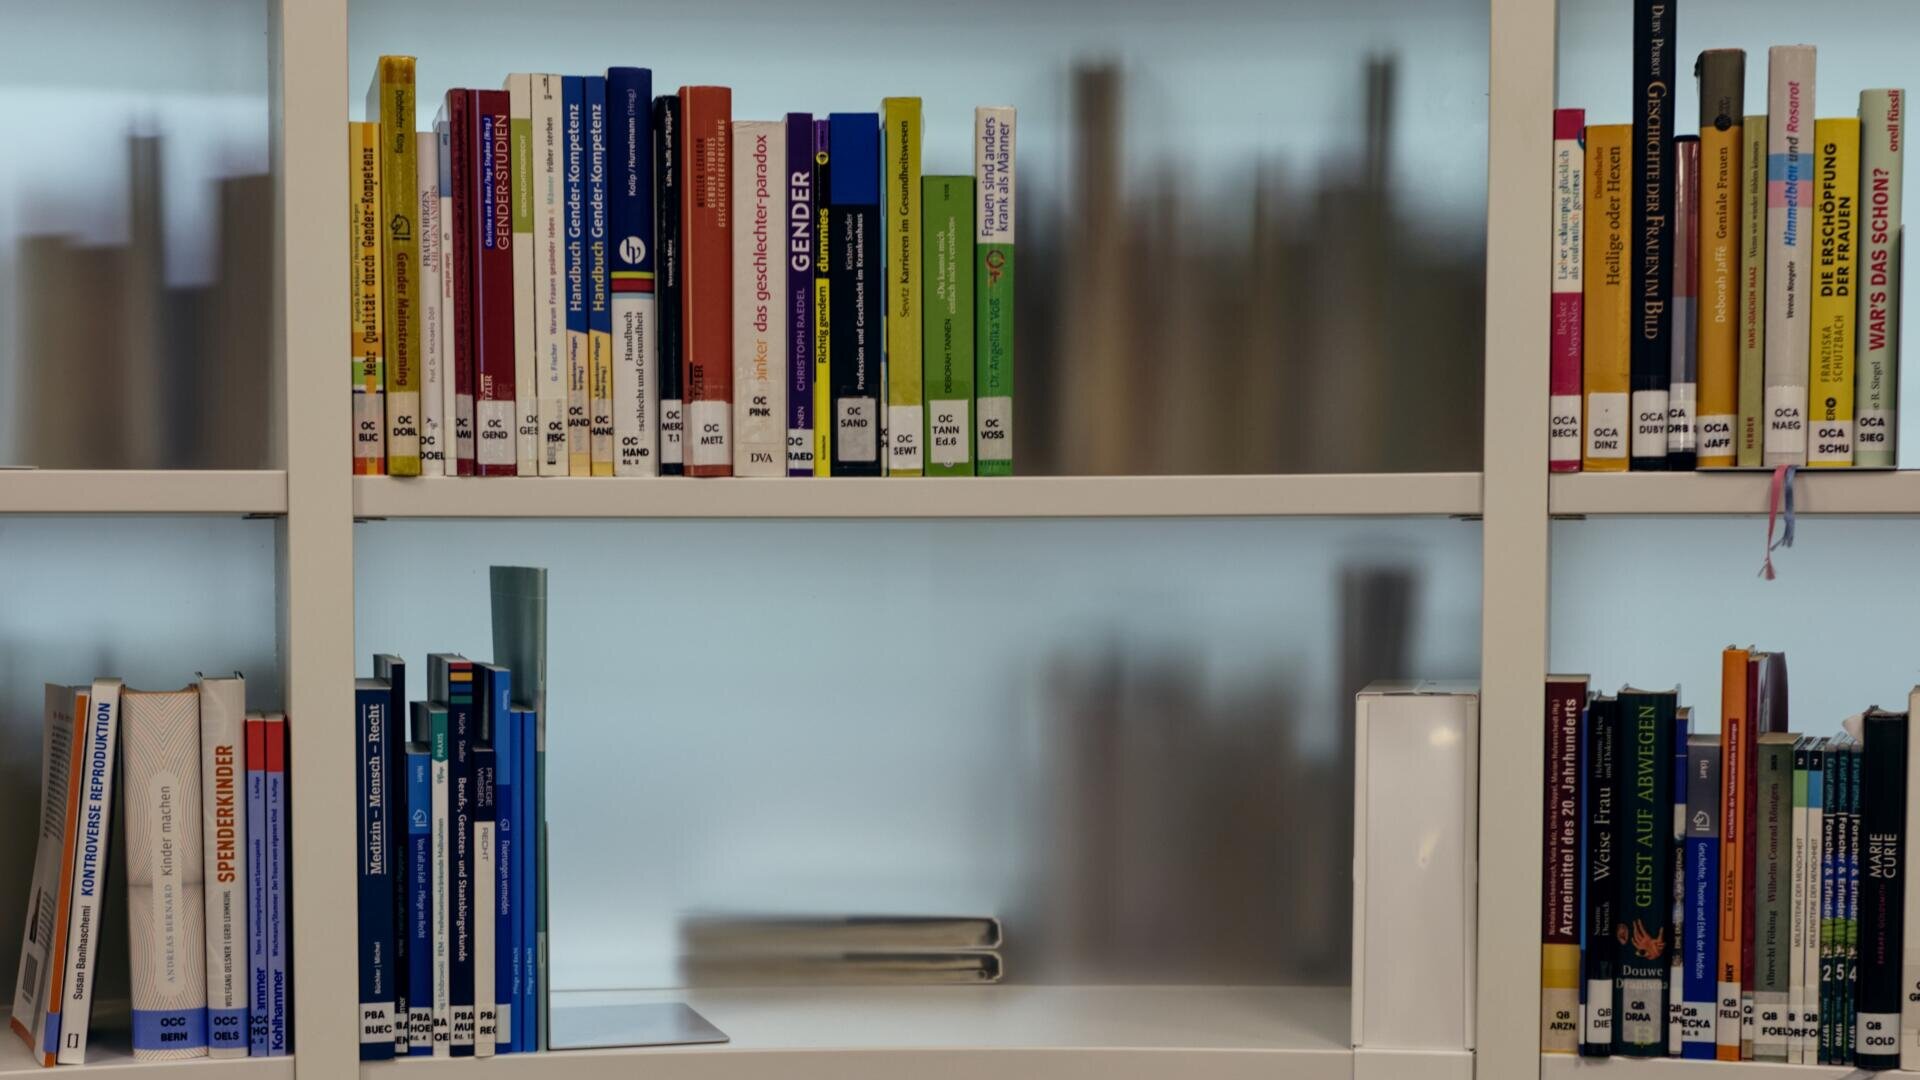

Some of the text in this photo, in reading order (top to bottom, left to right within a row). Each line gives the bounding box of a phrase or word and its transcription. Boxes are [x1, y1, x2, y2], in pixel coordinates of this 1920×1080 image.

[1887, 89, 1899, 152] orell füssli
[1784, 81, 1800, 246] Himmelblau und Rosarot
[707, 137, 716, 208] GENDER STUDIES
[982, 117, 995, 236] Frauen sind anders
[996, 122, 1009, 232] krank als Männer
[496, 114, 510, 249] GENDER-STUDIEN
[1716, 146, 1728, 239] Geniale Frauen
[568, 104, 582, 311] Handbuch Gender-Kompetenz
[591, 104, 605, 311] Handbuch Gender-Kompetenz
[1644, 81, 1667, 339] GESCHICHTE DER FRAUEN IM BILD
[753, 134, 770, 301] geschlechter-paradox
[898, 120, 910, 318] Sewtz Karrieren im Gesundheitswesen
[1558, 150, 1570, 280] Lieber schlampig glücklich
[1606, 146, 1623, 286] Heilige oder Hexen
[792, 172, 810, 272] GENDER
[1819, 143, 1837, 297] DIE ERSCHÖPFUNG
[422, 191, 432, 266] FRAUEN HERZEN
[817, 208, 828, 272] dummies
[1837, 197, 1850, 296] DER FRAUEN
[361, 146, 378, 376] Mehr Qualität durch Gender-Kompetenz
[1869, 168, 1889, 350] WAR'S DAS SCHON?
[856, 214, 864, 390] Profession und Geschlecht im Krankenhaus
[396, 252, 410, 385] Gender Mainstreaming
[753, 305, 768, 332] das
[818, 286, 828, 364] Richtig gendern
[624, 312, 633, 360] Handbuch
[797, 288, 805, 391] CHRISTOPH RAEDEL
[753, 397, 767, 405] OC
[667, 411, 680, 419] OC
[750, 408, 770, 416] PINK
[848, 407, 861, 415] OC
[398, 416, 412, 424] OC
[595, 416, 608, 424] OC
[939, 414, 953, 423] OC
[1553, 416, 1576, 425] OCA
[1640, 413, 1663, 421] OCA
[361, 422, 375, 430] OC
[488, 420, 502, 428] OC
[550, 422, 562, 430] OC
[841, 419, 867, 427] SAND
[1772, 422, 1800, 430] NAEG
[1860, 418, 1884, 426] OCA
[393, 428, 417, 436] DOBL
[704, 424, 719, 432] OC
[932, 426, 959, 434] TANN
[1639, 426, 1664, 434] DUBY
[1704, 424, 1728, 432] OCA
[483, 431, 508, 439] GEND
[981, 431, 1004, 439] VOSS
[1552, 429, 1578, 437] BECK
[1594, 429, 1618, 437] OCA
[1860, 433, 1884, 442] SIEG
[420, 436, 435, 445] OC
[622, 437, 638, 445] OC
[788, 438, 803, 446] OC
[898, 435, 912, 443] OC
[936, 437, 956, 446] Ed.6
[1704, 439, 1730, 447] JAFF
[1594, 441, 1617, 449] DINZ
[1819, 444, 1849, 453] SCHU
[623, 448, 649, 456] HAND
[894, 446, 917, 455] SEWT
[420, 452, 444, 460] DOEL
[751, 453, 772, 463] DVA
[788, 453, 813, 461] RAED
[368, 704, 382, 874] Medizin Mensch Recht
[81, 702, 110, 896] KONTROVERSE REPRODUKTION
[1635, 705, 1655, 907] GEIST AUF ABWEGEN
[215, 745, 235, 883] SPENDERKINDER
[1560, 699, 1577, 935] Arzneimittel des 20. Jahrhunderts
[158, 786, 173, 877] Kinder machen
[1593, 787, 1611, 881] Weise Frau
[481, 827, 489, 861] RECHT
[1869, 834, 1882, 878] MARIE
[1884, 834, 1897, 878] CURIE
[72, 905, 91, 1000] Susan Banihaschemi
[1623, 965, 1662, 976] Douwe
[1823, 966, 1831, 981] 2
[1836, 964, 1844, 980] 5
[1849, 966, 1857, 982] 4
[271, 969, 284, 1050] Kohlhammer
[1631, 1001, 1644, 1009] QB
[365, 1011, 385, 1019] PBA
[1556, 1011, 1569, 1019] QB
[1682, 1008, 1696, 1016] QB
[1762, 1012, 1777, 1020] QB
[214, 1016, 238, 1025] OCC
[411, 1013, 430, 1021] PBA
[160, 1017, 186, 1027] OCC
[1550, 1022, 1575, 1030] ARZN
[1866, 1022, 1881, 1030] QB
[365, 1025, 392, 1034] BUEC
[160, 1032, 187, 1042] BERN
[214, 1031, 239, 1040] OELS
[1866, 1037, 1895, 1046] GOLD
